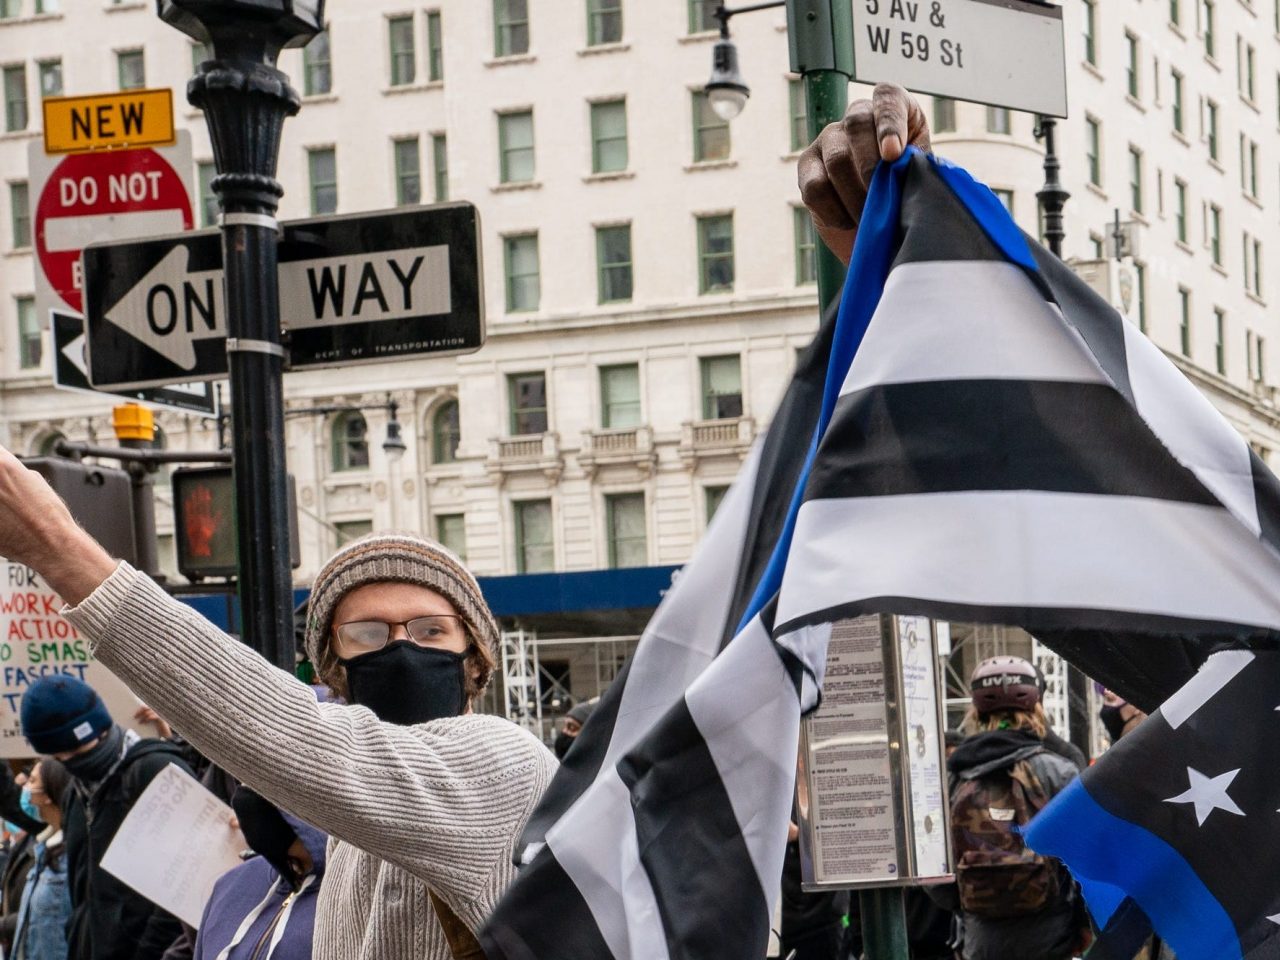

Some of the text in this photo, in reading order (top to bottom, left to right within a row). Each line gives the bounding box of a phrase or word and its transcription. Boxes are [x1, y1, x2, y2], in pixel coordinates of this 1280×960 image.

[890, 0, 918, 22] Av
[930, 1, 945, 28] &
[867, 25, 963, 68] W 59 St
[71, 102, 144, 141] NEW
[60, 171, 162, 207] DO NOT
[146, 256, 424, 336] ON WAY
[315, 351, 340, 359] DEPT
[375, 338, 465, 352] TRANSPORTATION
[8, 566, 39, 588] FOR
[0, 592, 64, 617] WORK
[27, 640, 95, 663] SMAS
